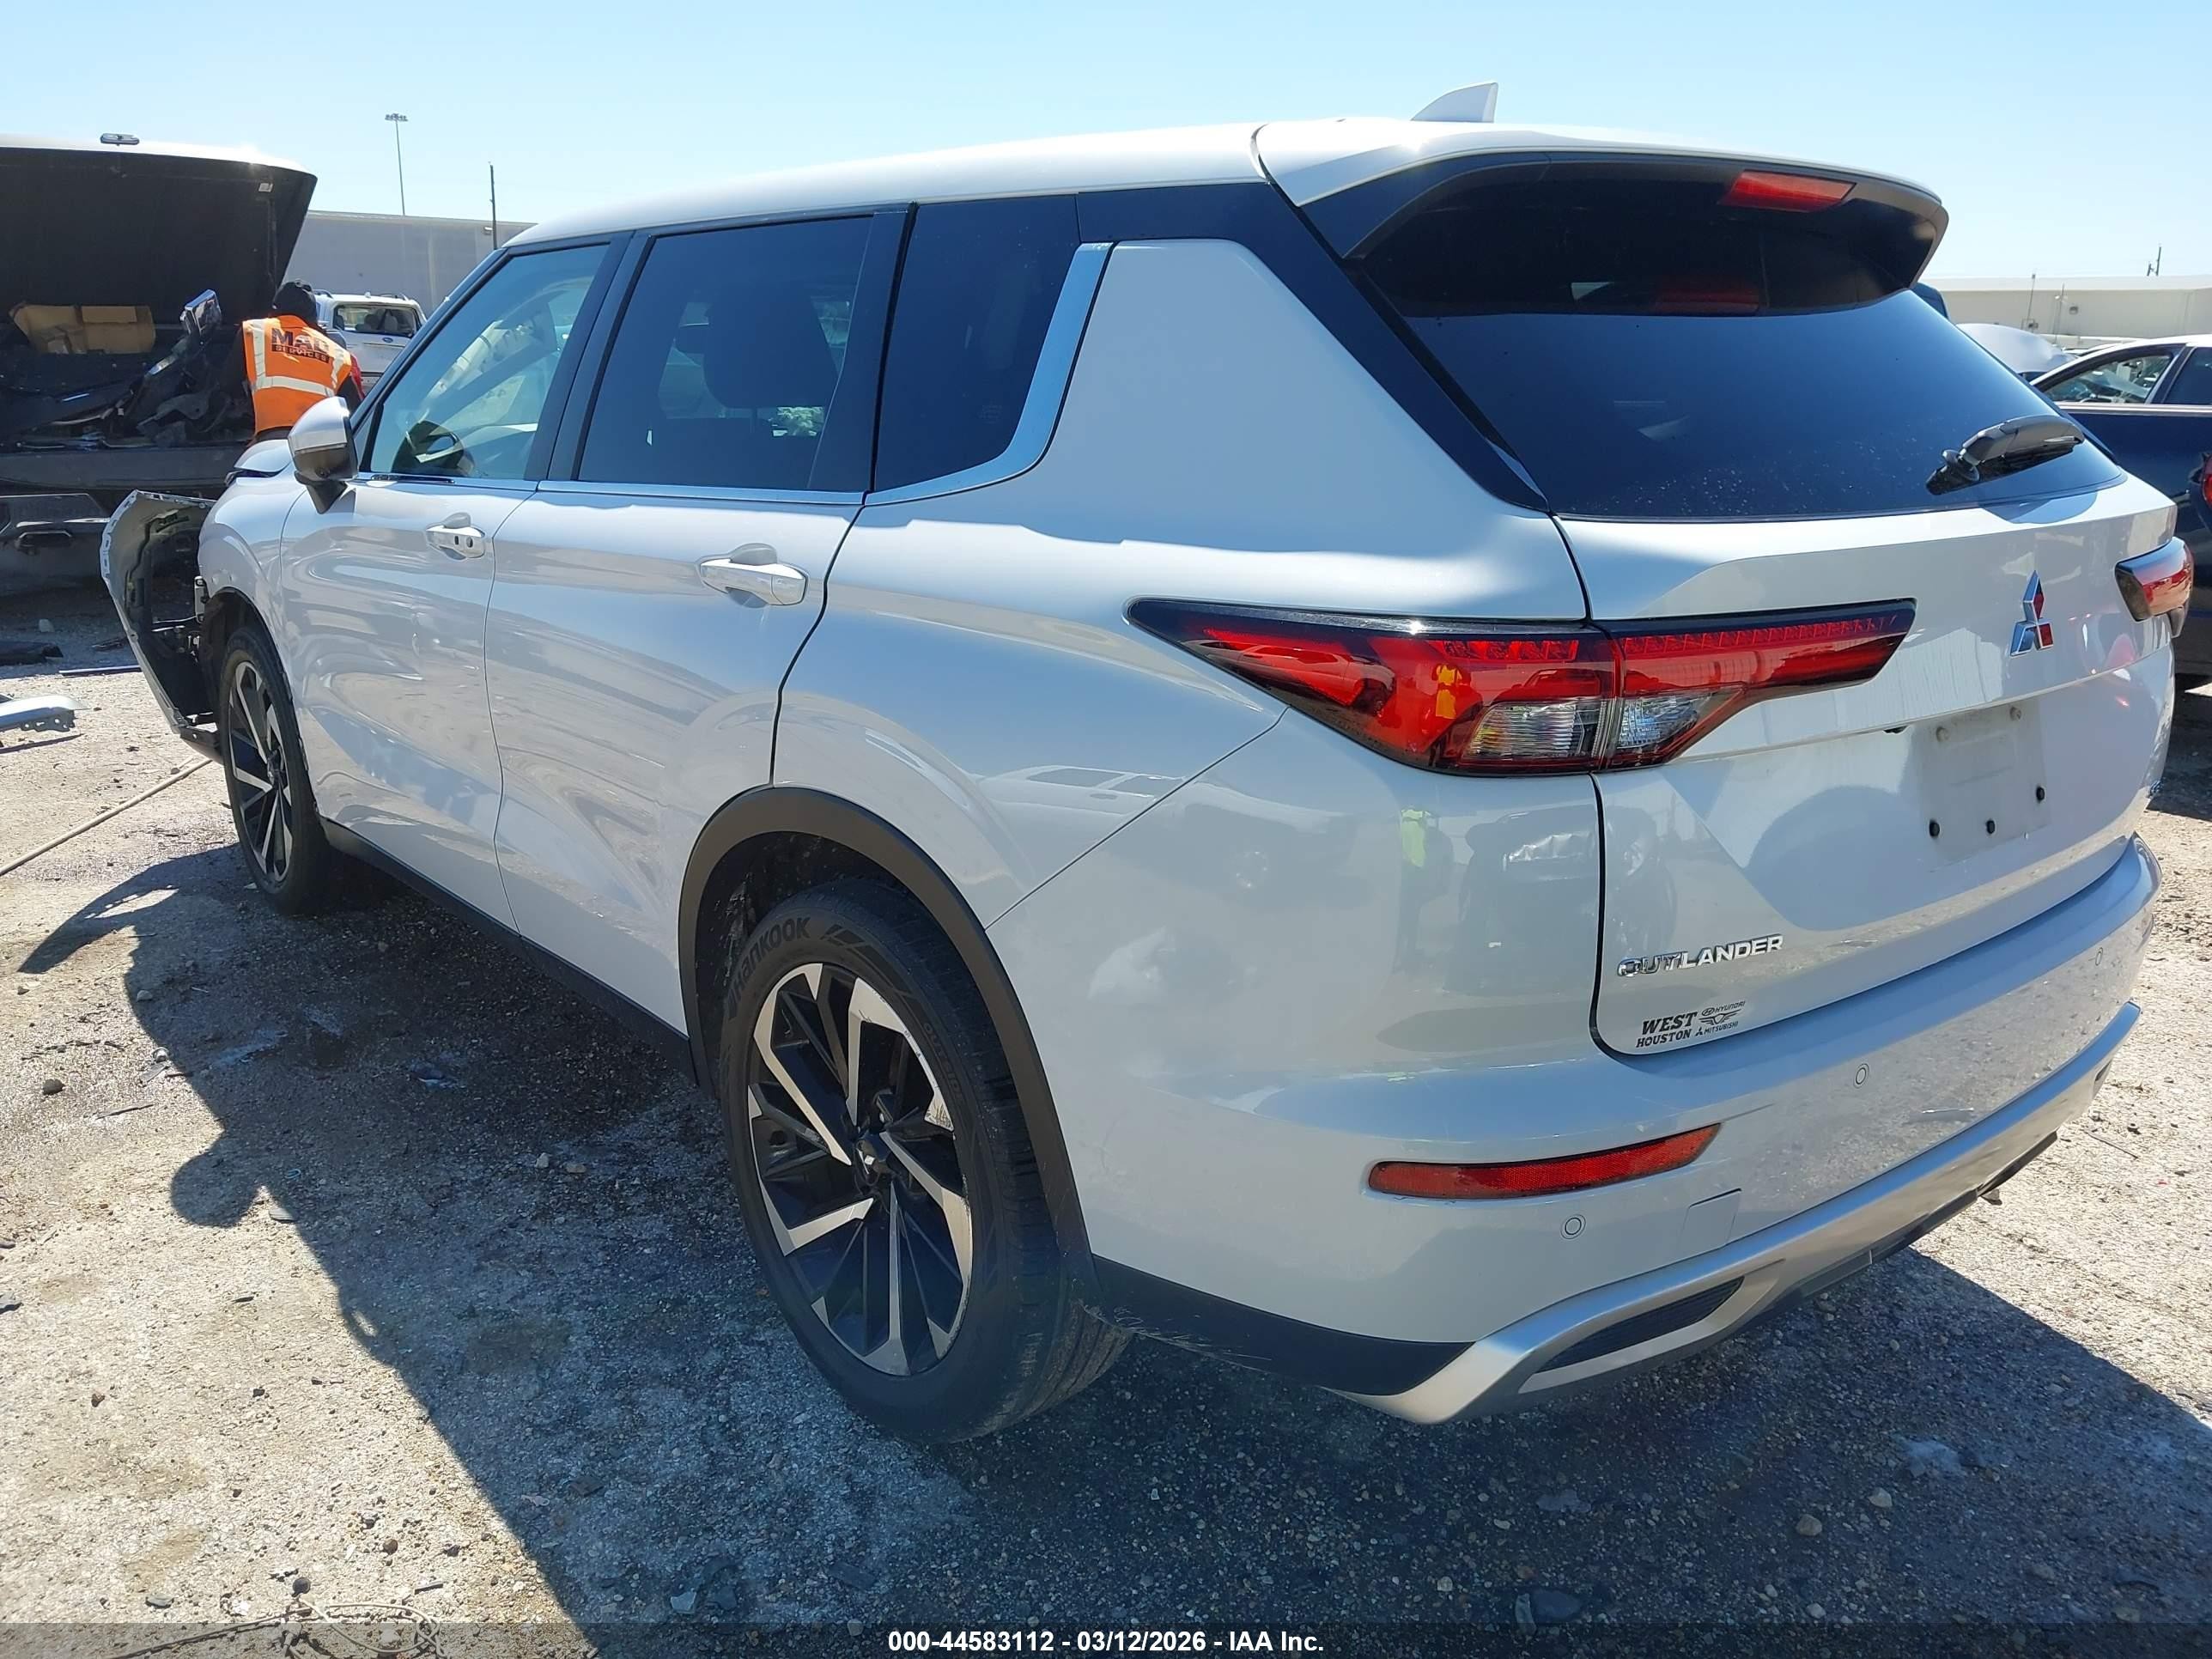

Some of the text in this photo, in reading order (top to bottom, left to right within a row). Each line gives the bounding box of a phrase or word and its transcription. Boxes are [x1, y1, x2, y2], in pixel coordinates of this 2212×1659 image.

[1617, 933, 1784, 977] OUTLANDER
[1715, 1000, 1746, 1013] HYUNDAI
[1641, 1011, 1698, 1036] WEST
[1704, 1021, 1739, 1036] MITSUBISHI
[1635, 1028, 1692, 1048] HOUSTON
